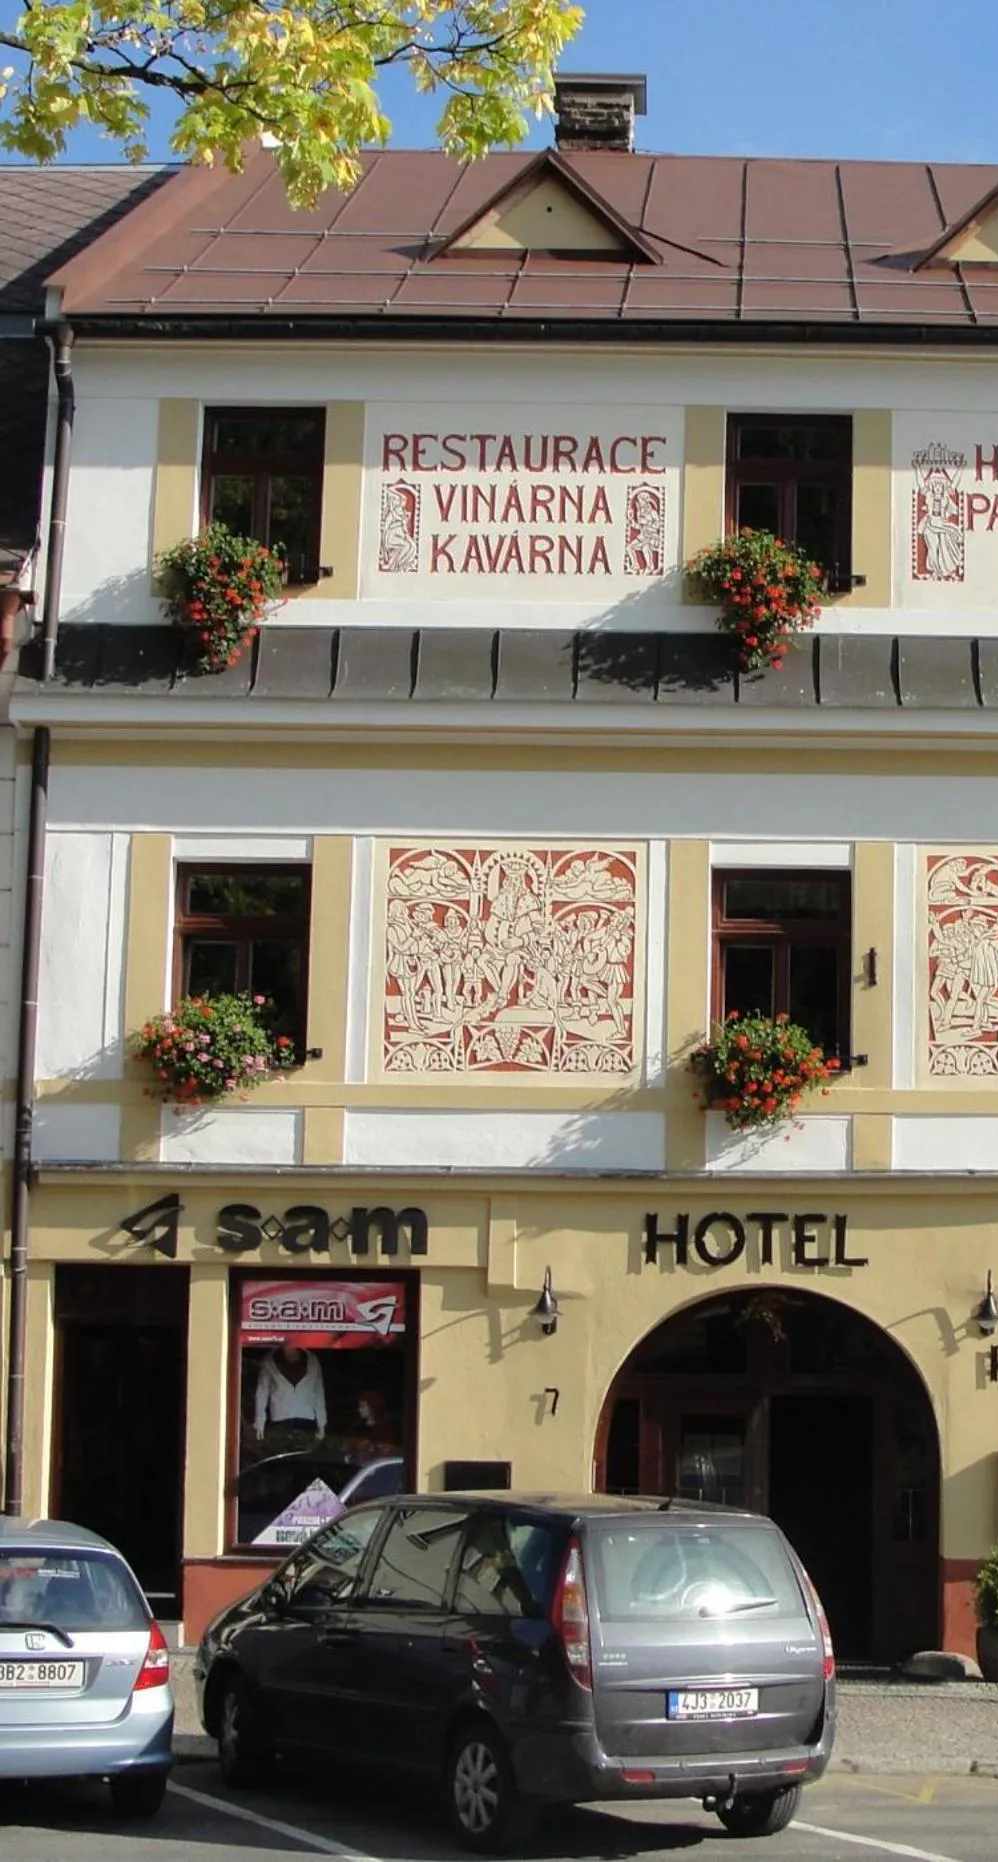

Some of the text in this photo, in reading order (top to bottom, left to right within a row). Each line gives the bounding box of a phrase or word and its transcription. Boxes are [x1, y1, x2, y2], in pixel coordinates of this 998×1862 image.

[382, 434, 667, 474] RESTAURACE
[433, 479, 613, 524] VINÁRNA
[429, 530, 613, 575] KAVÁRNA
[644, 1211, 869, 1268] HOTEL
[544, 1387, 560, 1415] 7
[38, 1664, 77, 1681] 8807
[681, 1692, 708, 1710] 4J3
[718, 1691, 752, 1709] 2037
